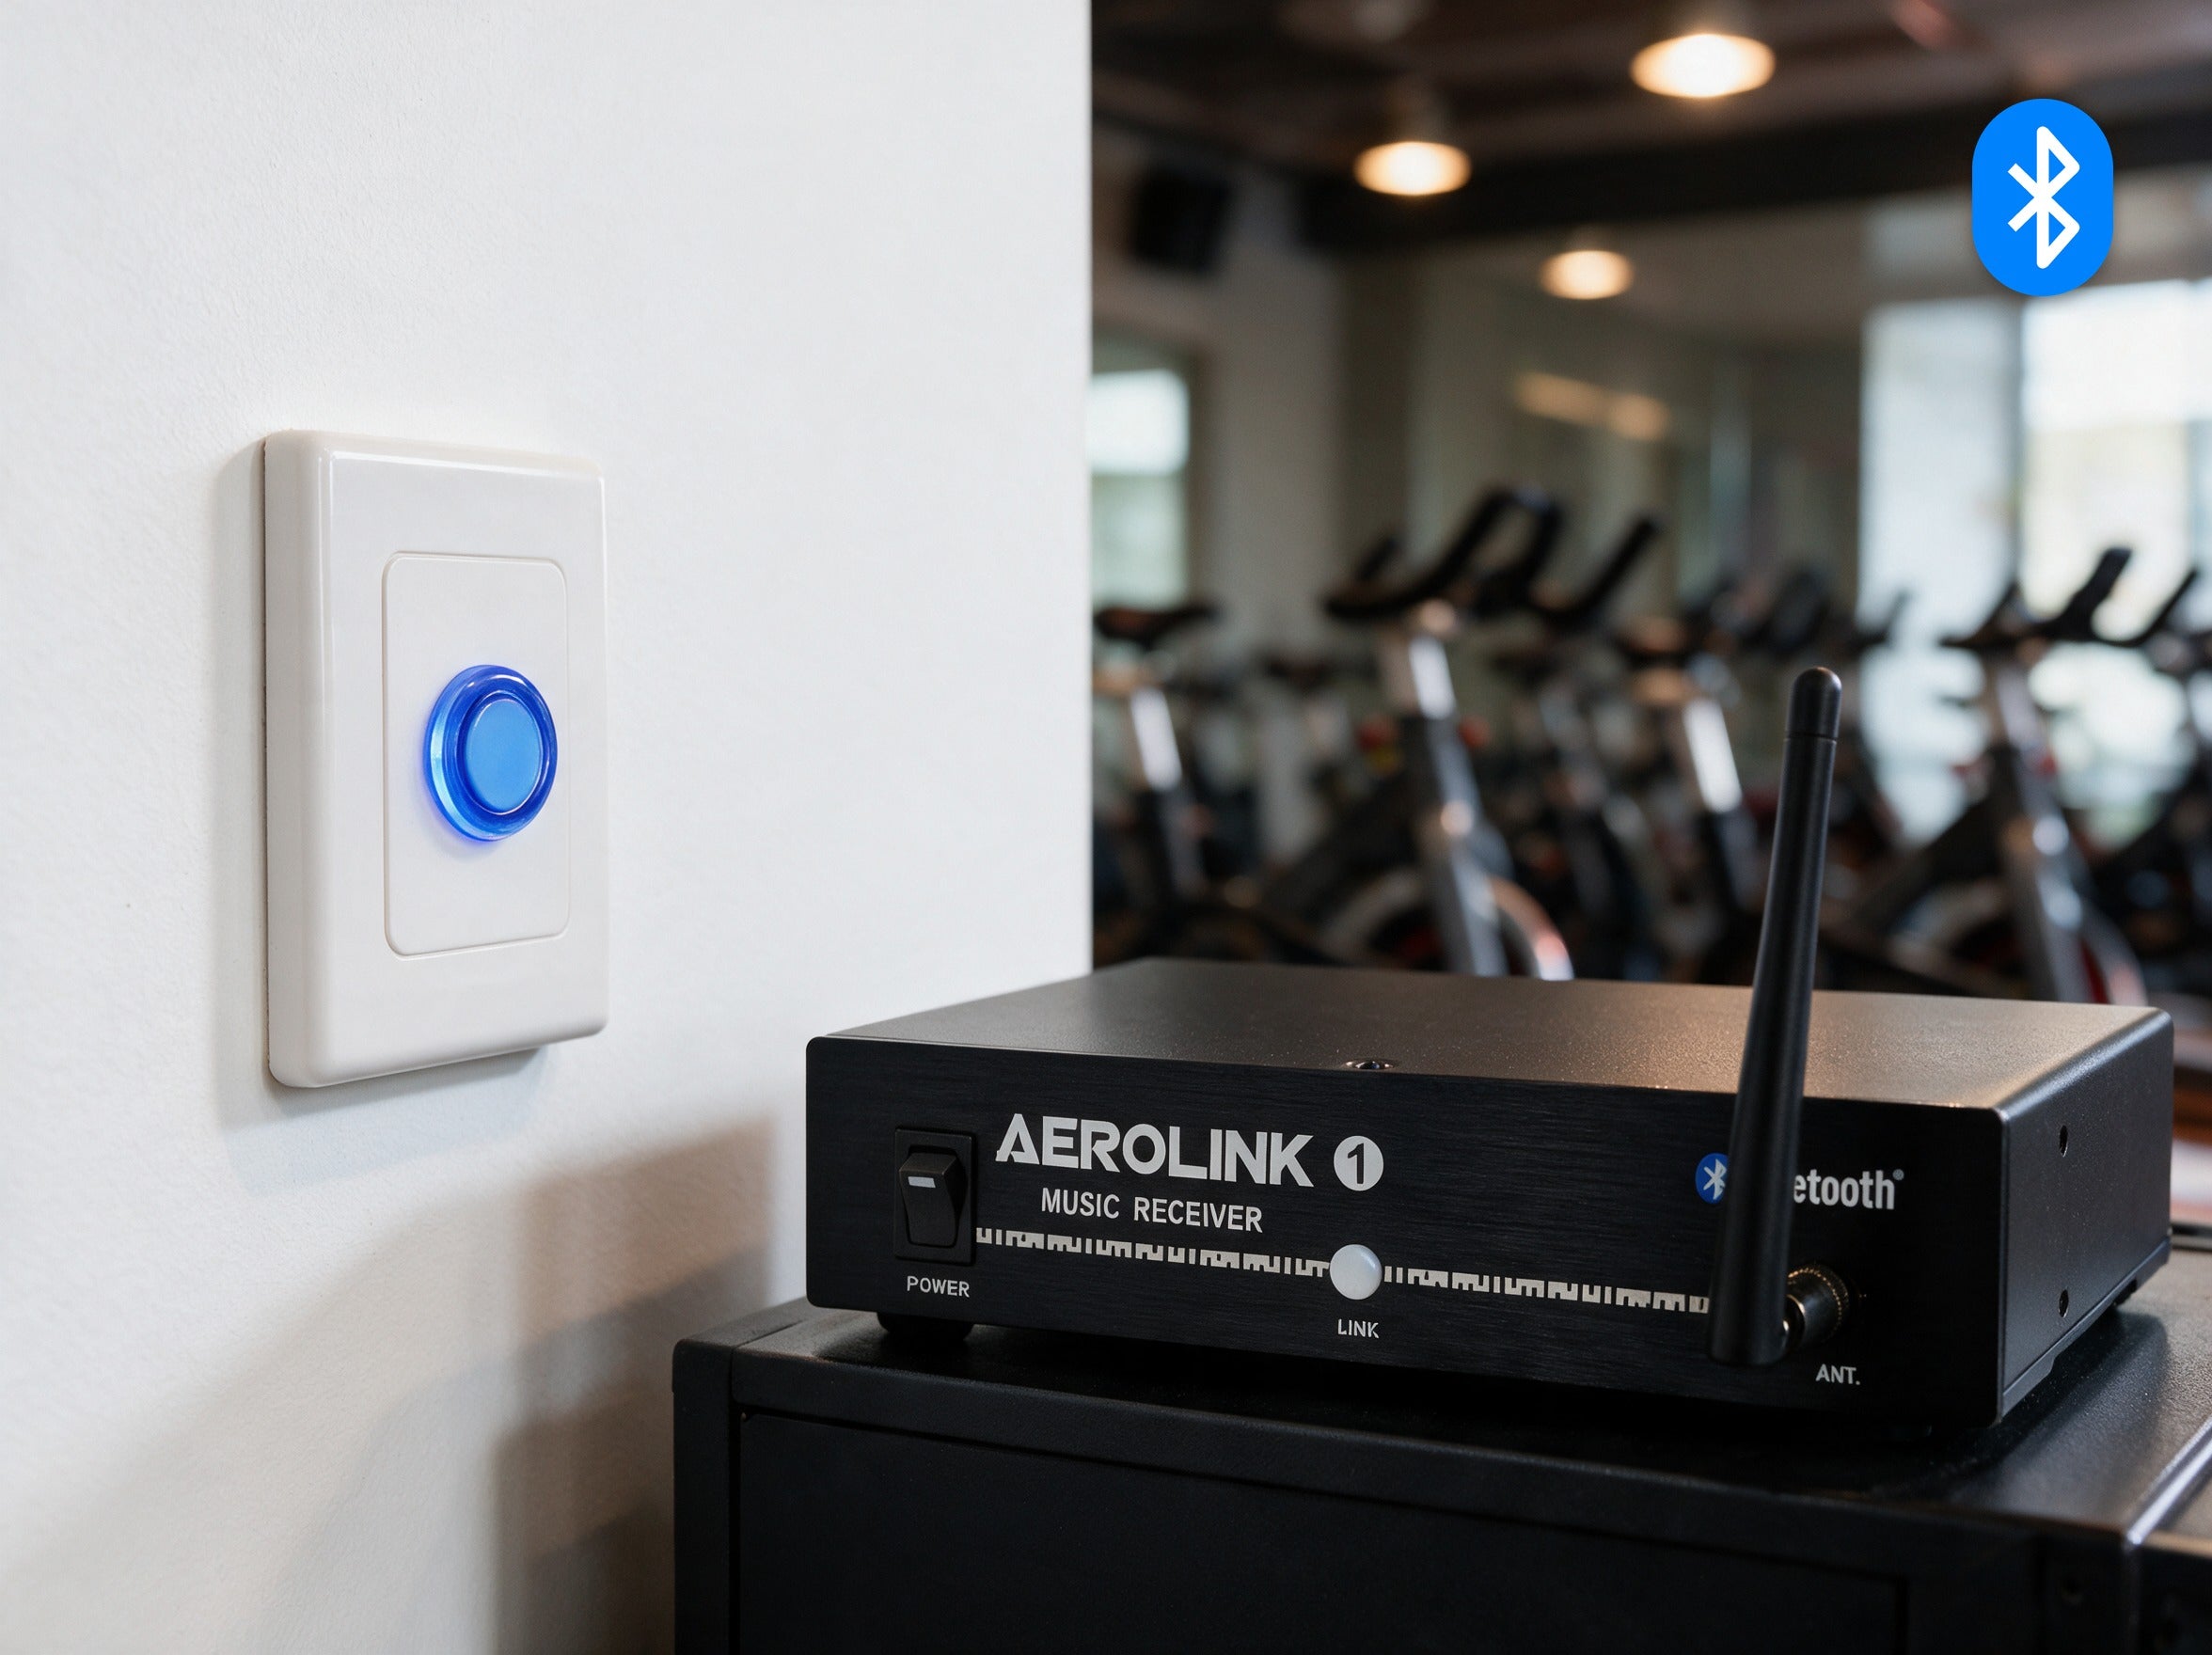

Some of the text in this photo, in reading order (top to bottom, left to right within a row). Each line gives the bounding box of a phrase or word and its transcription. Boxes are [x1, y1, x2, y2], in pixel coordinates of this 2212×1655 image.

[995, 1113, 1315, 1188] AEROLINK
[1793, 1169, 1894, 1210] etooth
[1041, 1187, 1263, 1234] MUSIC RECEIVER
[907, 1275, 971, 1298] POWER
[1337, 1318, 1380, 1339] LINK
[1815, 1363, 1861, 1385] ANT.
